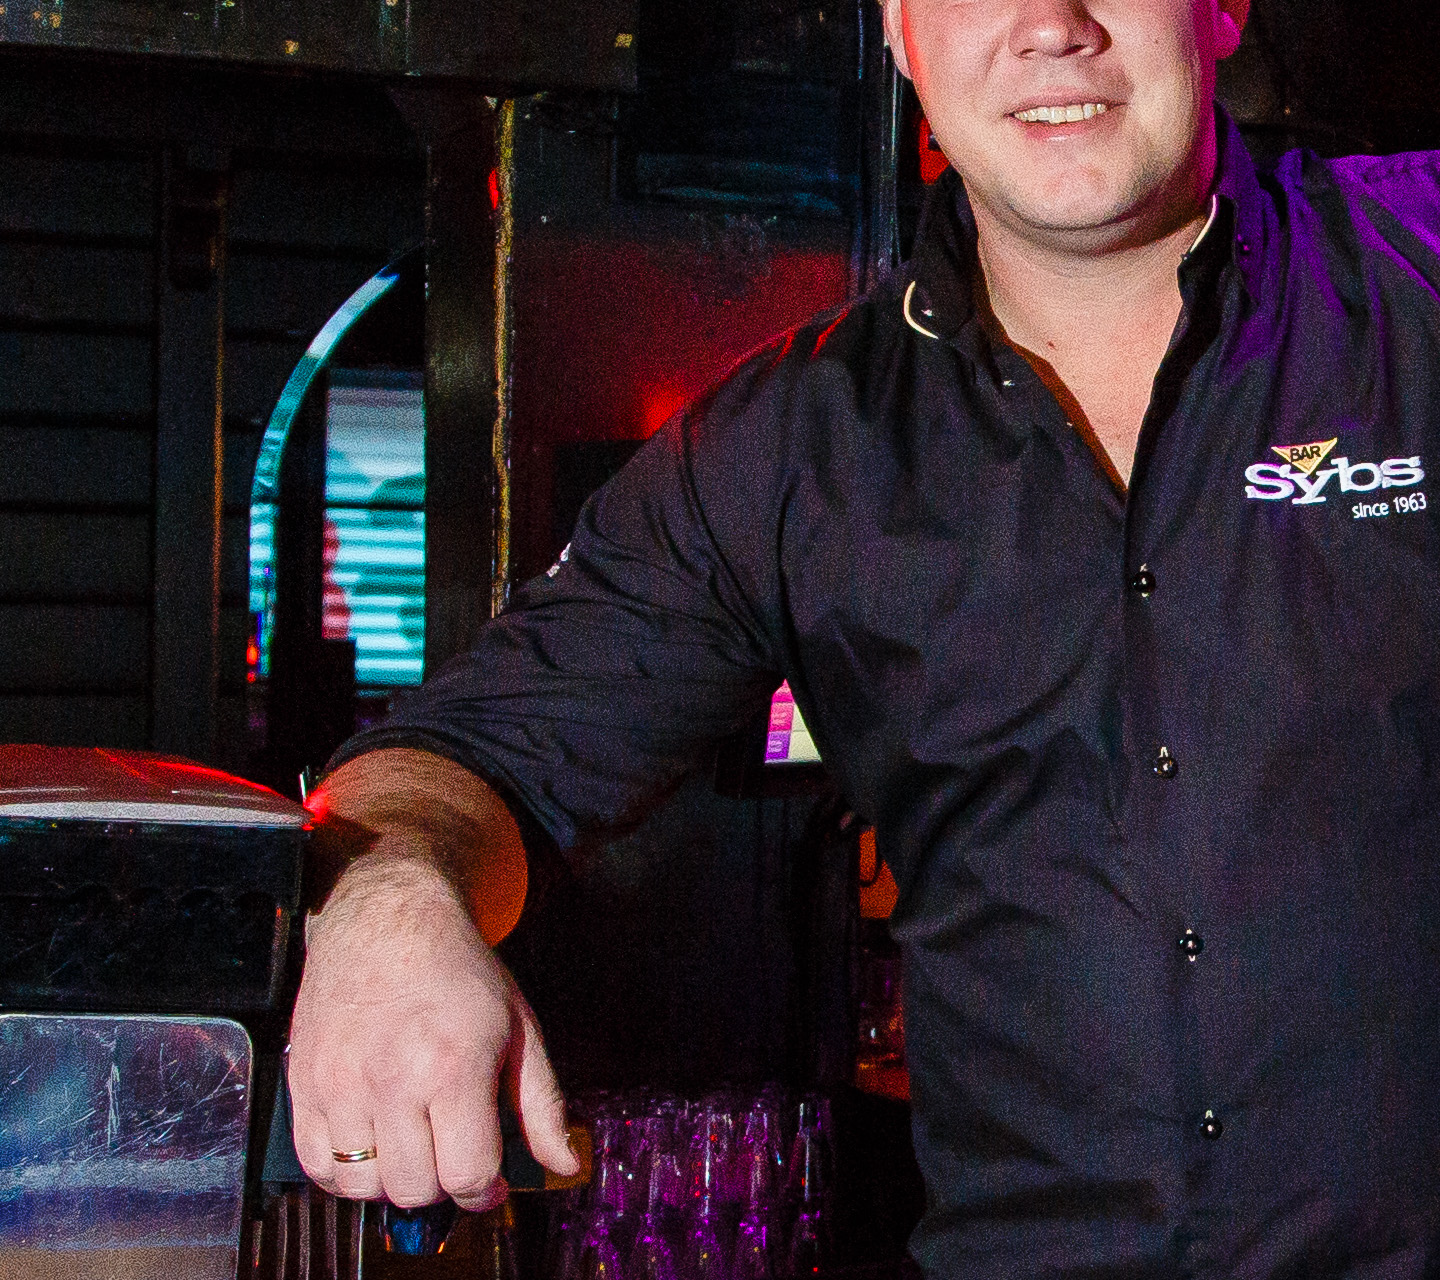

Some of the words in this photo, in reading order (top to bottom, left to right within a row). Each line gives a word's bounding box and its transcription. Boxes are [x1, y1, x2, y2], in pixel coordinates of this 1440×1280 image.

[1289, 445, 1322, 462] BAR
[1244, 455, 1426, 505] Sybs
[1352, 501, 1389, 519] since
[1393, 492, 1427, 514] 1963
